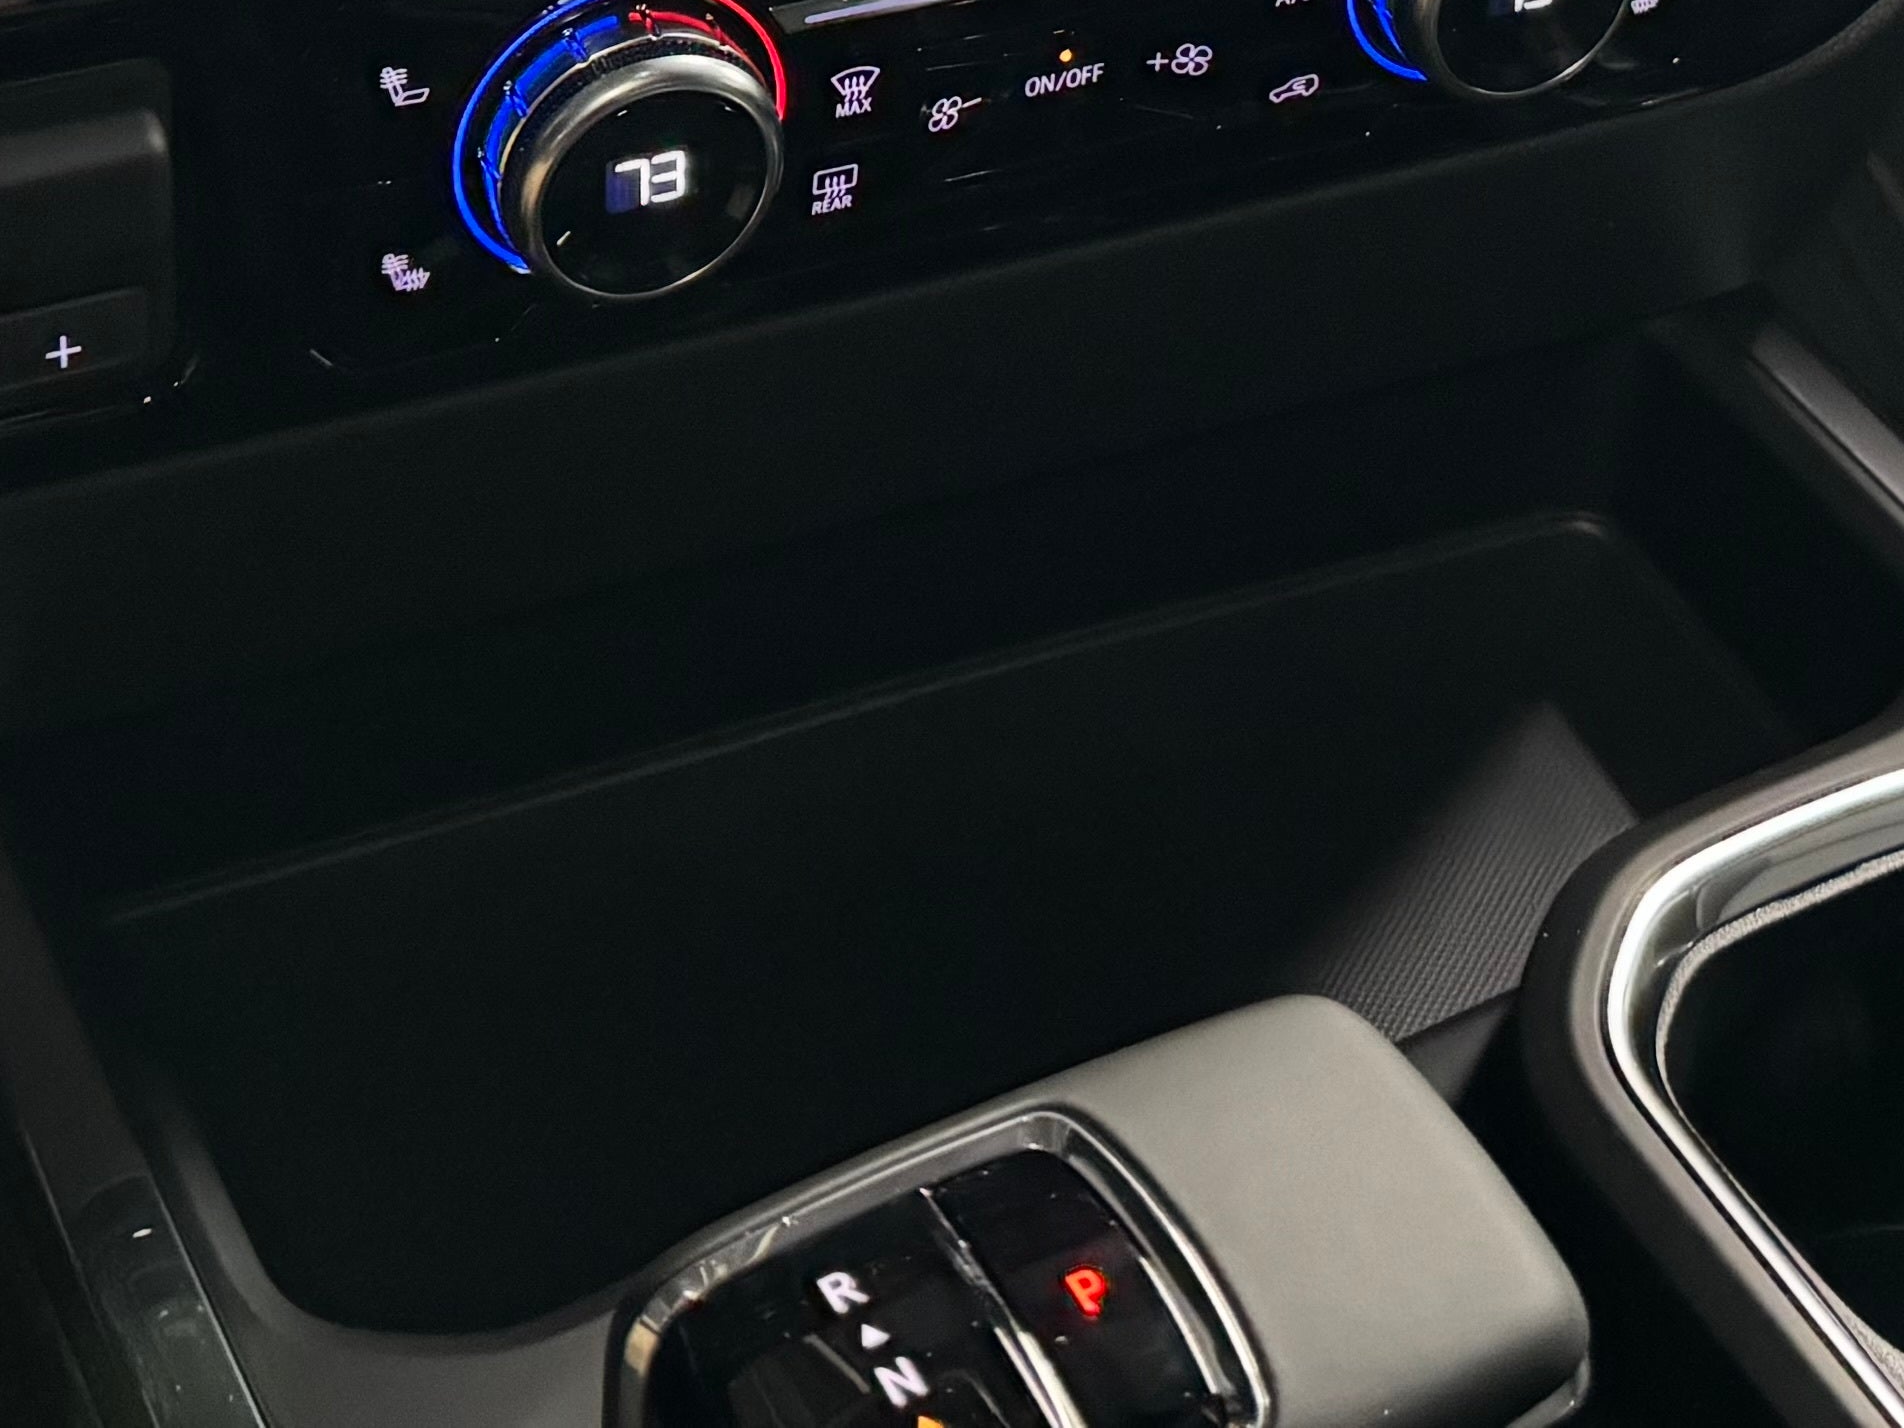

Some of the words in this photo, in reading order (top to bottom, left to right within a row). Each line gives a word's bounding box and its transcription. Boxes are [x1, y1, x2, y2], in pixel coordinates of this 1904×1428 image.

[1025, 63, 1105, 97] ON/OFF
[835, 97, 872, 119] MAX
[614, 150, 688, 206] 73
[811, 195, 853, 216] REAR
[816, 1271, 870, 1314] R
[1064, 1267, 1109, 1319] P
[873, 1356, 929, 1407] N
